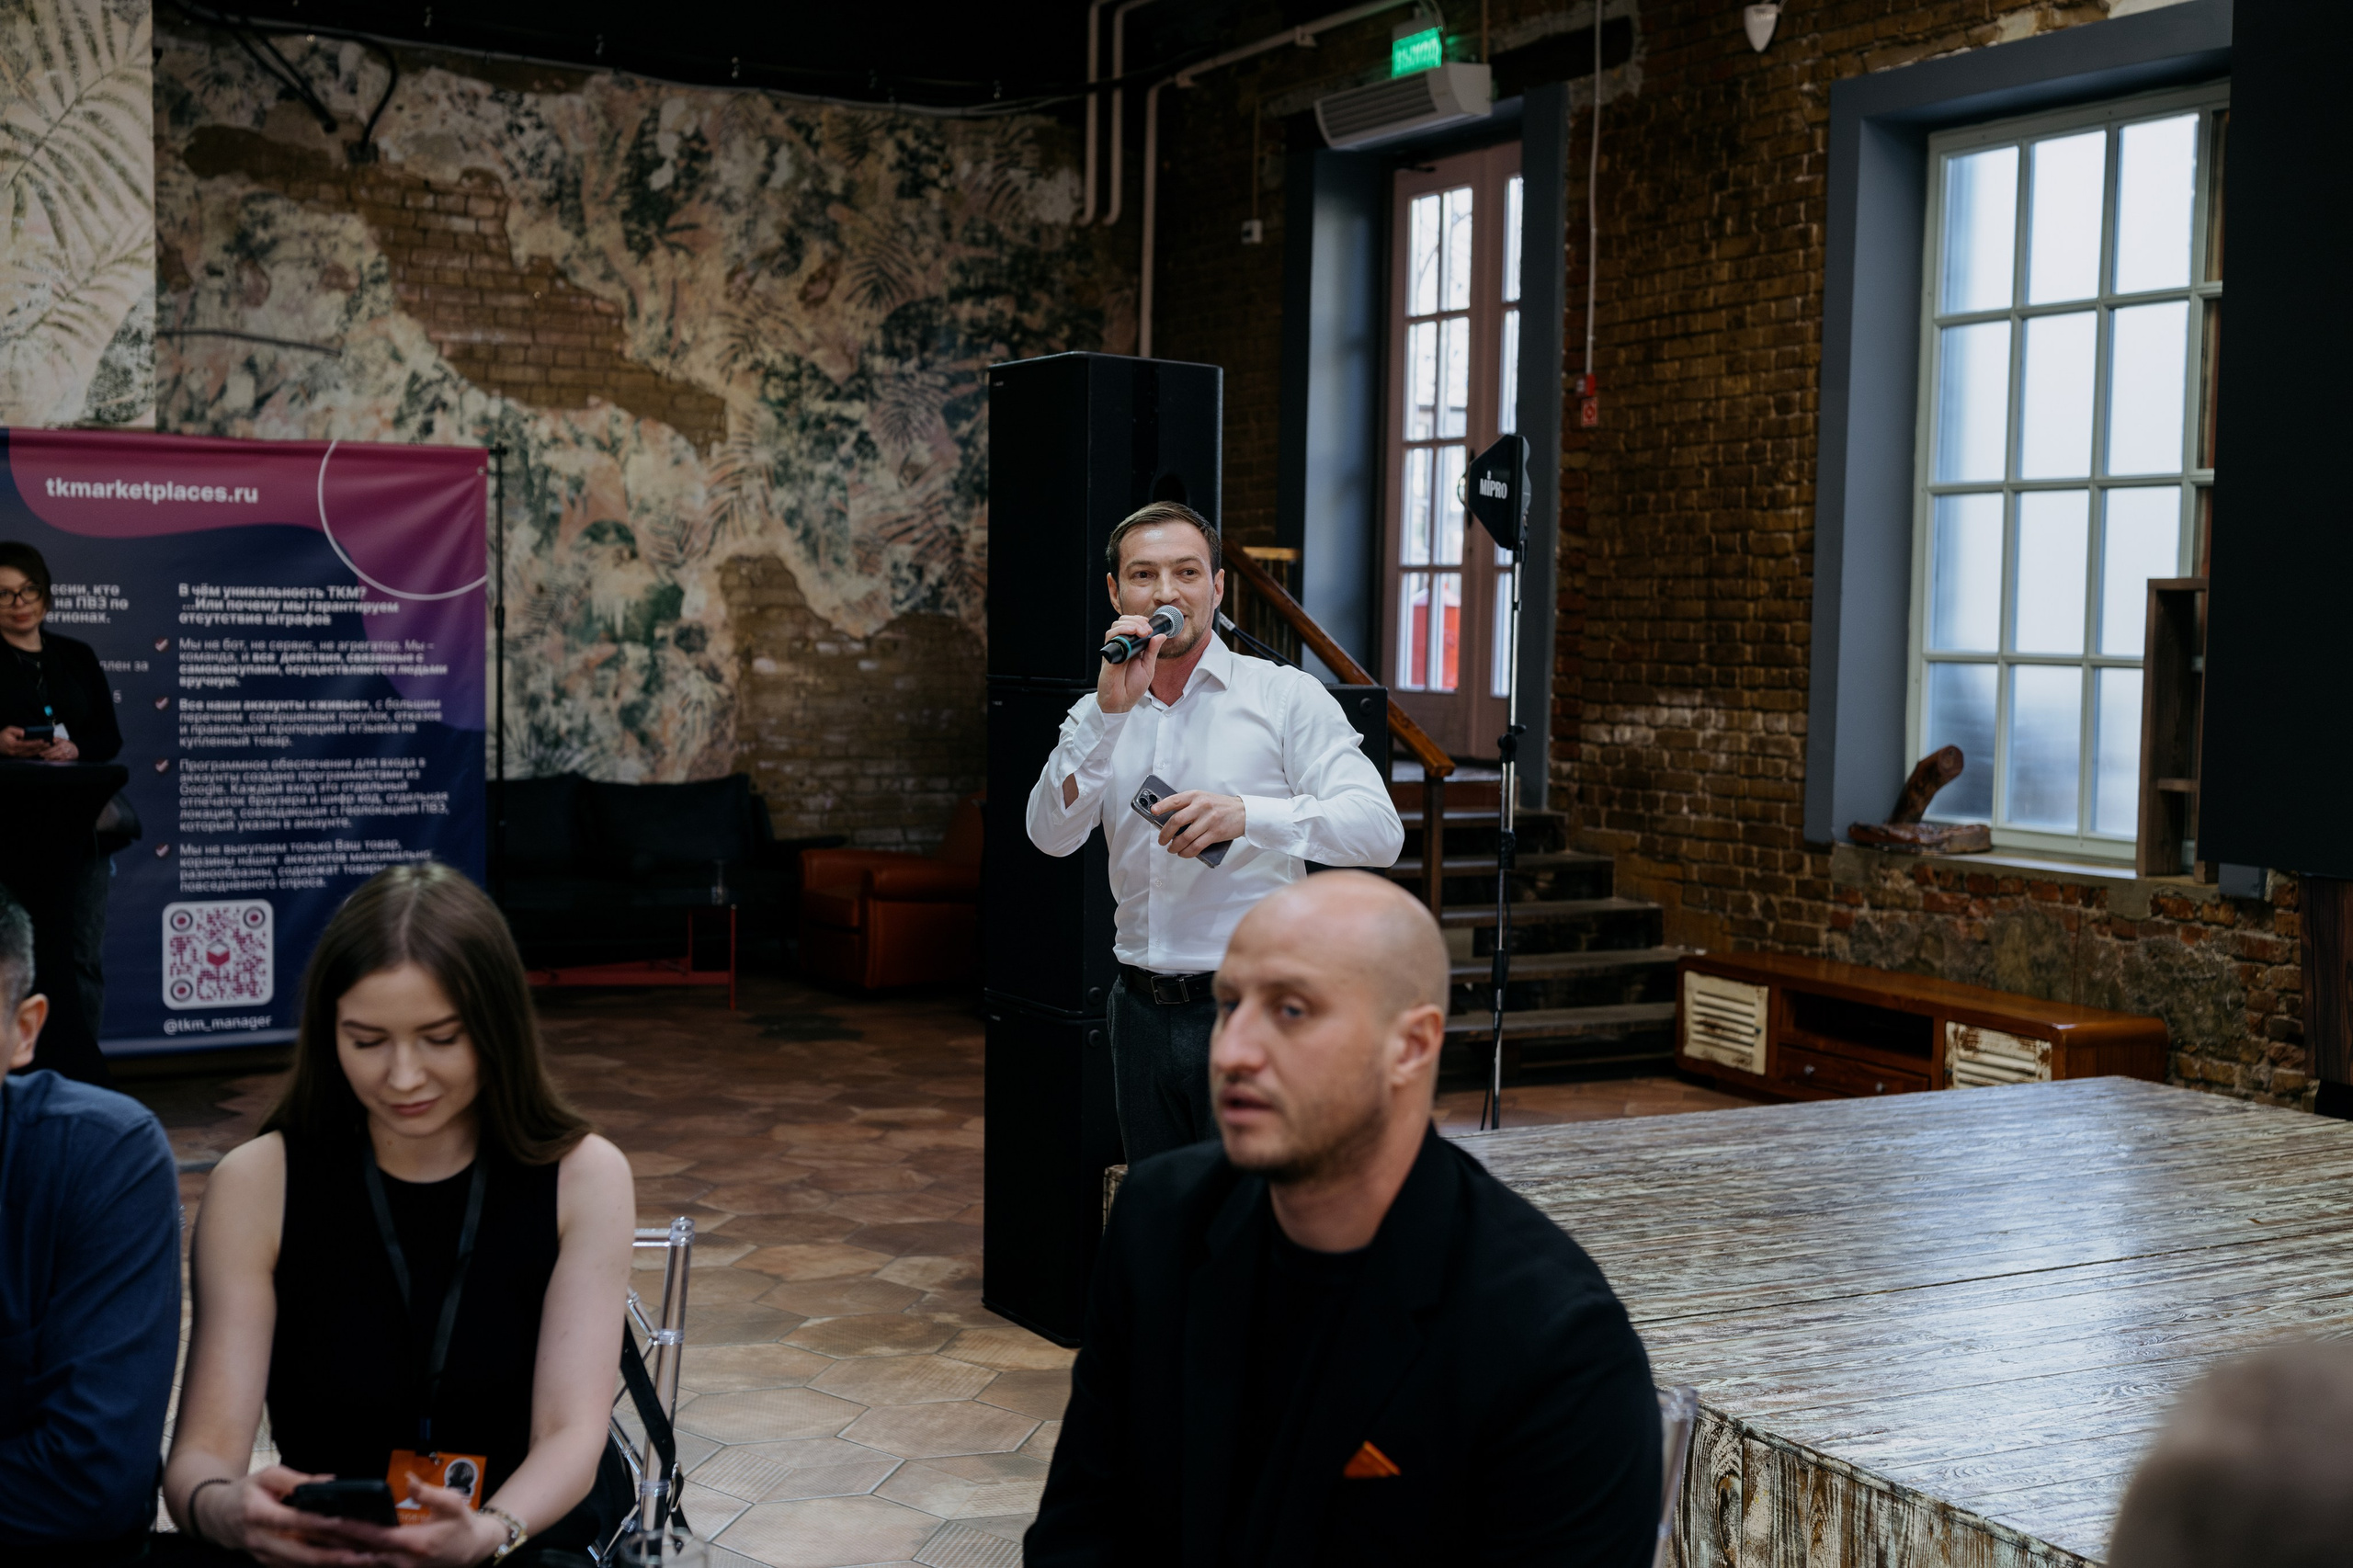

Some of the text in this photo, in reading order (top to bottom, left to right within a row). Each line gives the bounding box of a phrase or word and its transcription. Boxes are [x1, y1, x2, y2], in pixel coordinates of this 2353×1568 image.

[46, 478, 257, 504] tkmarketplaces.ru
[51, 584, 90, 596] ссии,
[179, 584, 188, 597] В
[223, 586, 324, 599] уникальность
[327, 585, 367, 600] ТКМ?
[226, 600, 279, 613] почему
[283, 601, 305, 611] мы
[308, 601, 399, 615] гарантируем
[45, 612, 111, 623] егионах.
[179, 613, 331, 628] отсутствие штрафов
[179, 638, 201, 651] Мы
[204, 640, 221, 651] не
[251, 641, 267, 651] не
[320, 641, 335, 651] не
[404, 640, 426, 652] Мы
[347, 653, 414, 663] связанные
[397, 664, 448, 676] людьми
[206, 700, 241, 710] наши
[244, 699, 305, 712] аккаунты
[385, 699, 440, 710] большим
[179, 712, 243, 724] перечнем
[394, 710, 442, 722] отказов
[179, 735, 249, 748] купленный
[180, 758, 268, 773] Программное
[271, 758, 352, 771] обеспечение
[380, 757, 416, 770] входа
[179, 771, 240, 784] аккаунты
[230, 783, 283, 796] Каждый
[342, 780, 409, 794] отдельный
[179, 796, 245, 808] отпечаток
[164, 1016, 272, 1035] @tkm_manager
